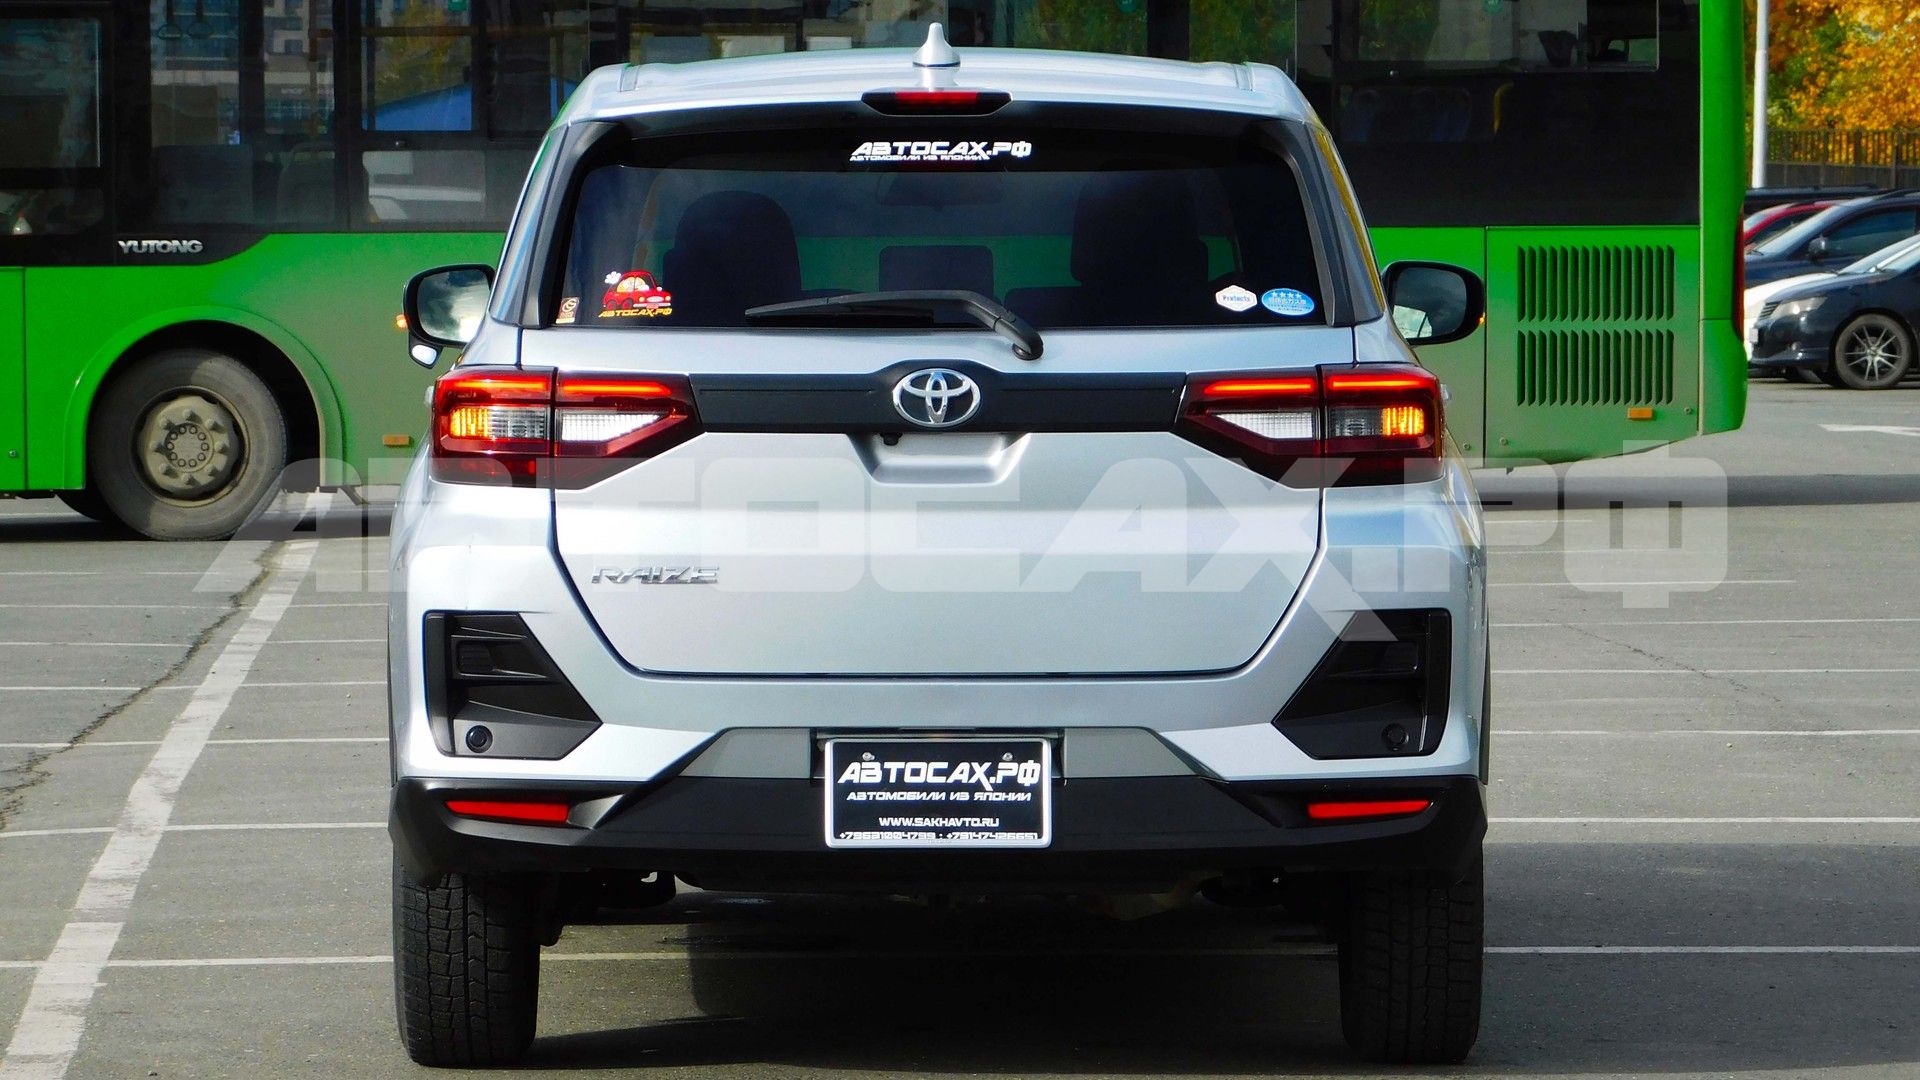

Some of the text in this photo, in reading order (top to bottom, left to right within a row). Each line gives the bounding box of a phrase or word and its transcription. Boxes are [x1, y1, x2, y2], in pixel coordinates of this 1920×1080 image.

[851, 141, 1032, 160] АВТОСАХ.РФ
[118, 239, 203, 254] YUTONG
[598, 308, 672, 317] АВТОСАХ.РФ
[591, 566, 719, 584] RAIZE
[837, 760, 1041, 791] АВТОСАХ.РФ
[846, 792, 1032, 802] АВТОМОБИЛИ ИЗ ЯПОНИИ
[879, 817, 1000, 828] WWW.SAKHAVTO.RU
